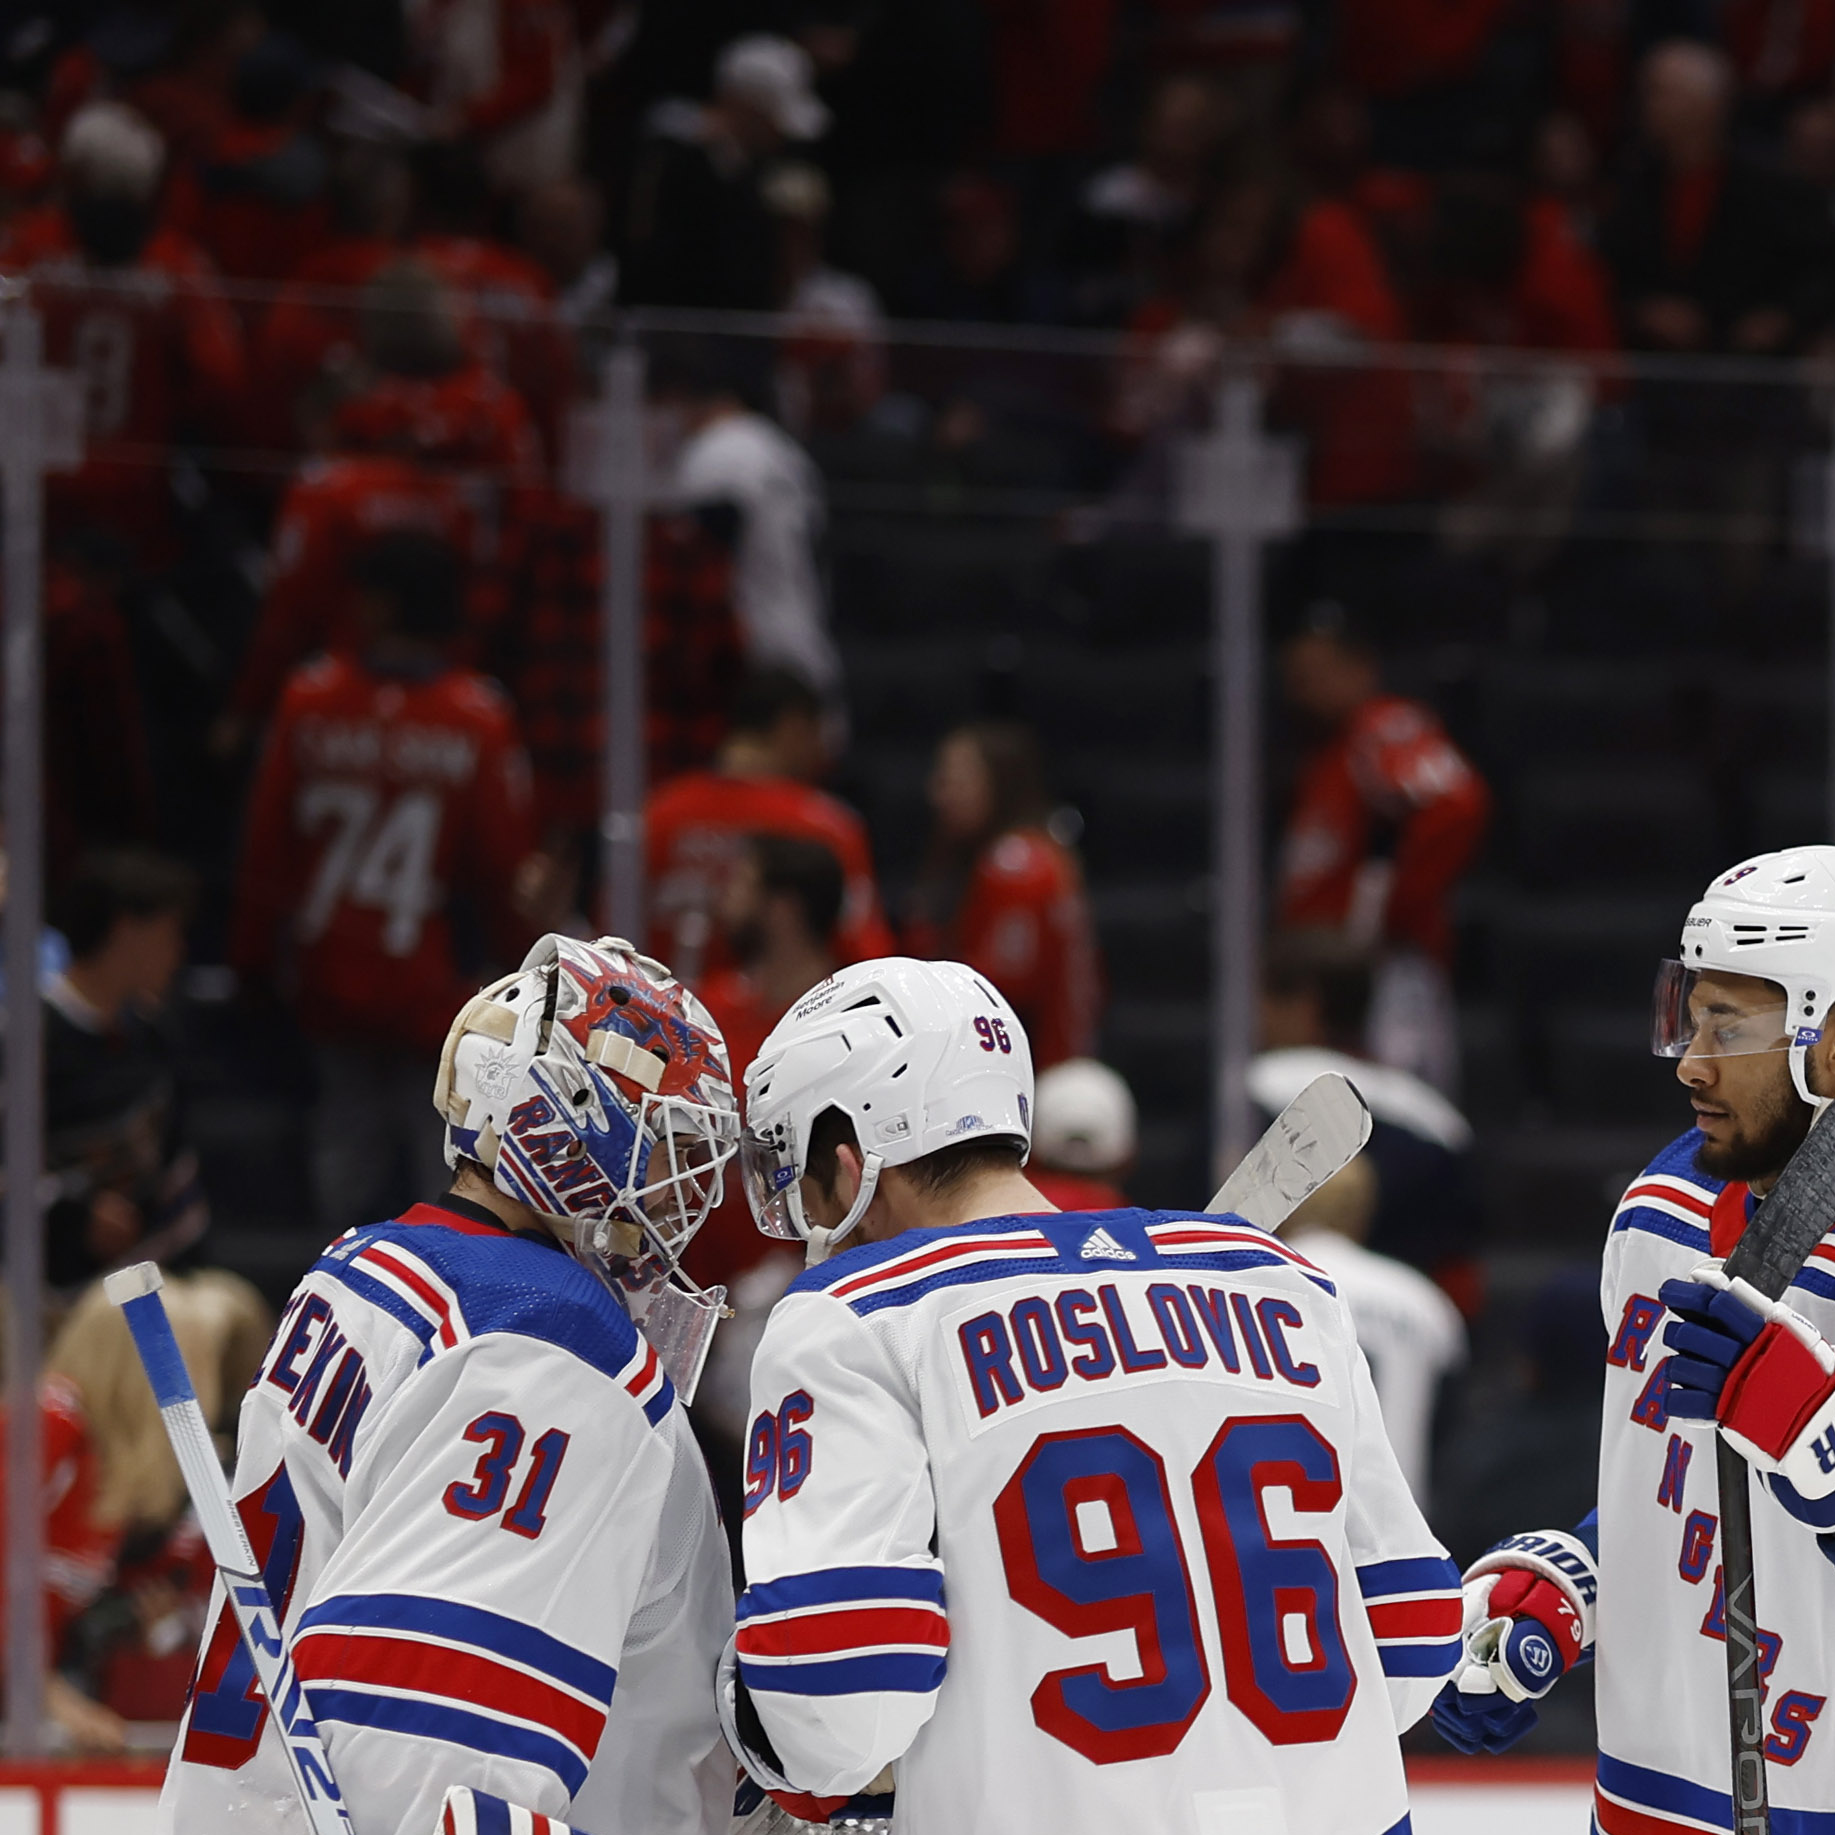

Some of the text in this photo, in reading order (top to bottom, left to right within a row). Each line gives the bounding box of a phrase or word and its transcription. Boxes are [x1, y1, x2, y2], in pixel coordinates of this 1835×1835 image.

[295, 798, 446, 956] 74
[973, 1016, 1012, 1054] 96
[1081, 1247, 1137, 1260] adidas
[957, 1281, 1323, 1420] ROSLOVIC
[442, 1410, 571, 1540] 31
[741, 1388, 815, 1521] 96
[992, 1412, 1359, 1766] 96
